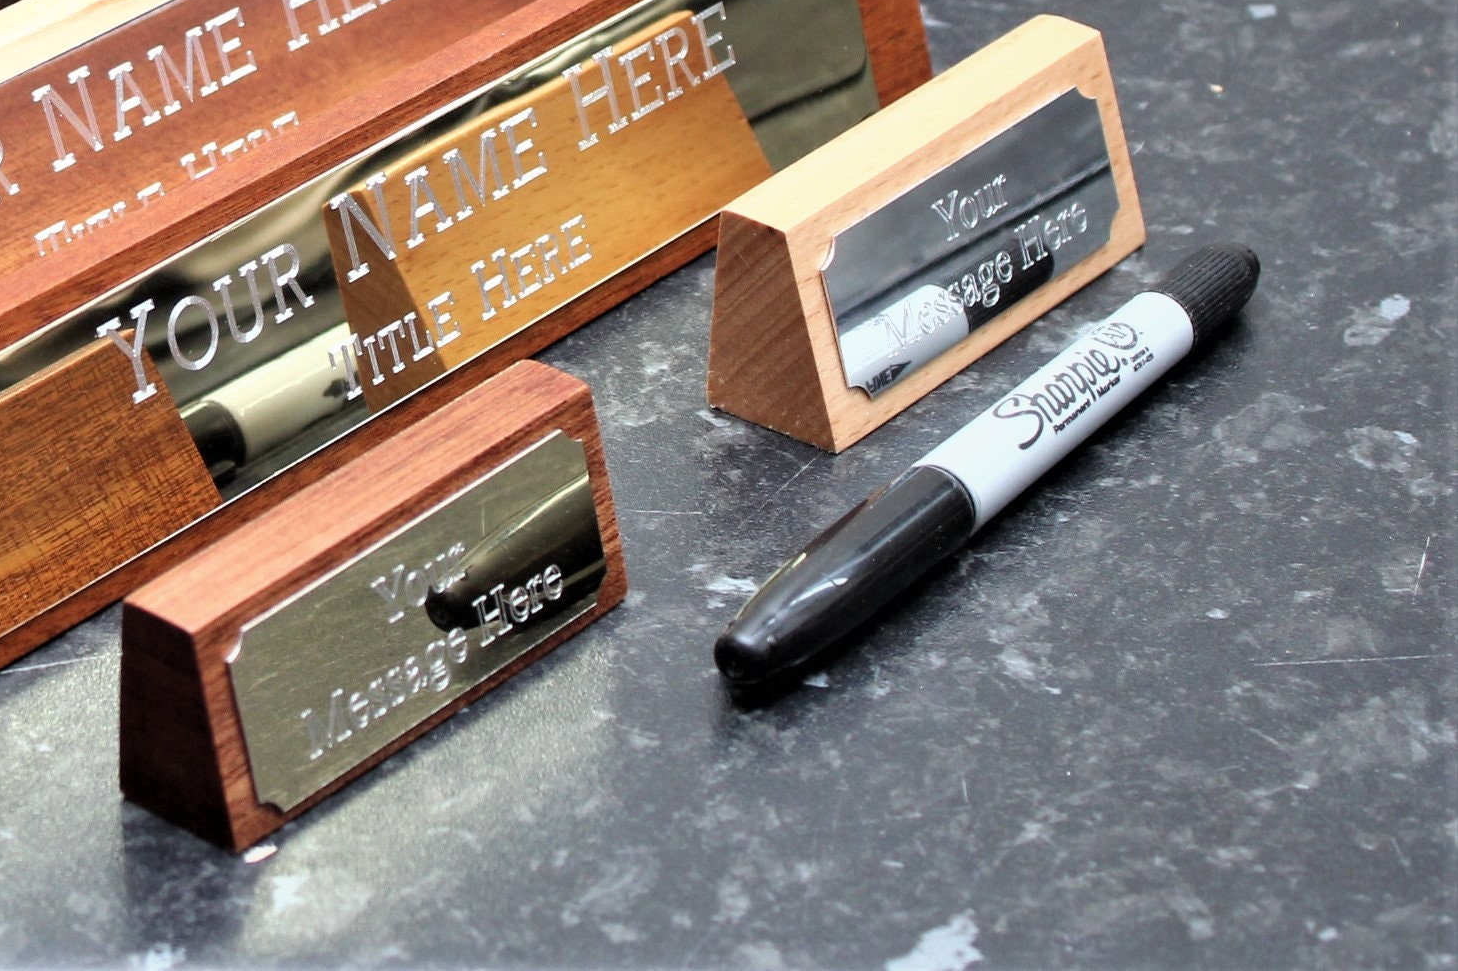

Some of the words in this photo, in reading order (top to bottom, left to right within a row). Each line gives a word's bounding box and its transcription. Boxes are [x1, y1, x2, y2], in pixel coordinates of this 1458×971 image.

[32, 7, 257, 171] NAME
[94, 242, 315, 405] YOUR
[329, 107, 547, 284] NAME
[561, 0, 736, 151] HERE
[875, 248, 1014, 359] Message
[1013, 200, 1089, 270] Here
[930, 173, 1009, 242] Your
[328, 290, 462, 401] TITLE
[469, 214, 593, 321] HERE
[992, 348, 1122, 450] Sharpie
[1053, 398, 1091, 435] Permanent
[1095, 374, 1122, 399] Marker
[300, 626, 468, 761] Message
[472, 563, 564, 648] Here
[370, 542, 468, 624] Your
